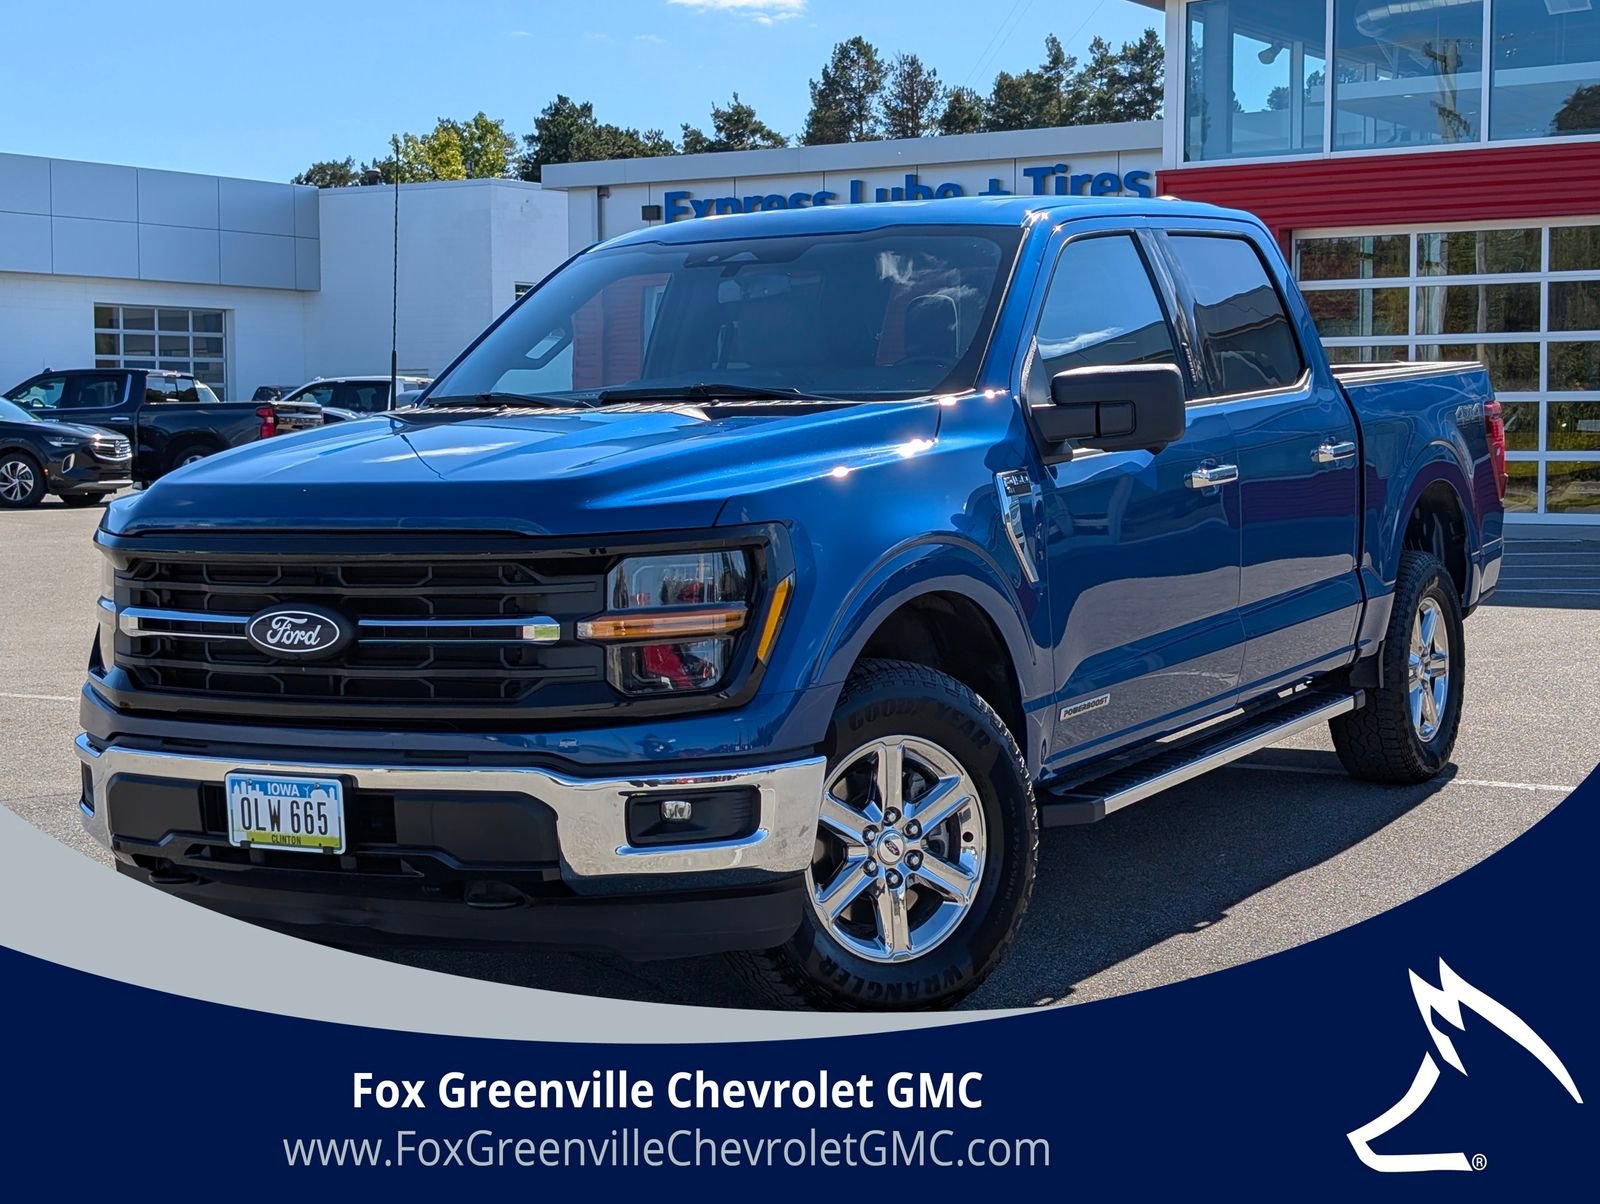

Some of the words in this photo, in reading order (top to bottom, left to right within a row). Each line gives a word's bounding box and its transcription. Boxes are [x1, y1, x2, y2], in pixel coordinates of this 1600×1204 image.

[1023, 163, 1151, 198] Tires
[266, 616, 321, 645] Ford
[267, 782, 300, 797] IOWA
[290, 800, 328, 835] 665
[271, 834, 301, 845] CLINTON
[819, 955, 962, 1000] WRANGLER
